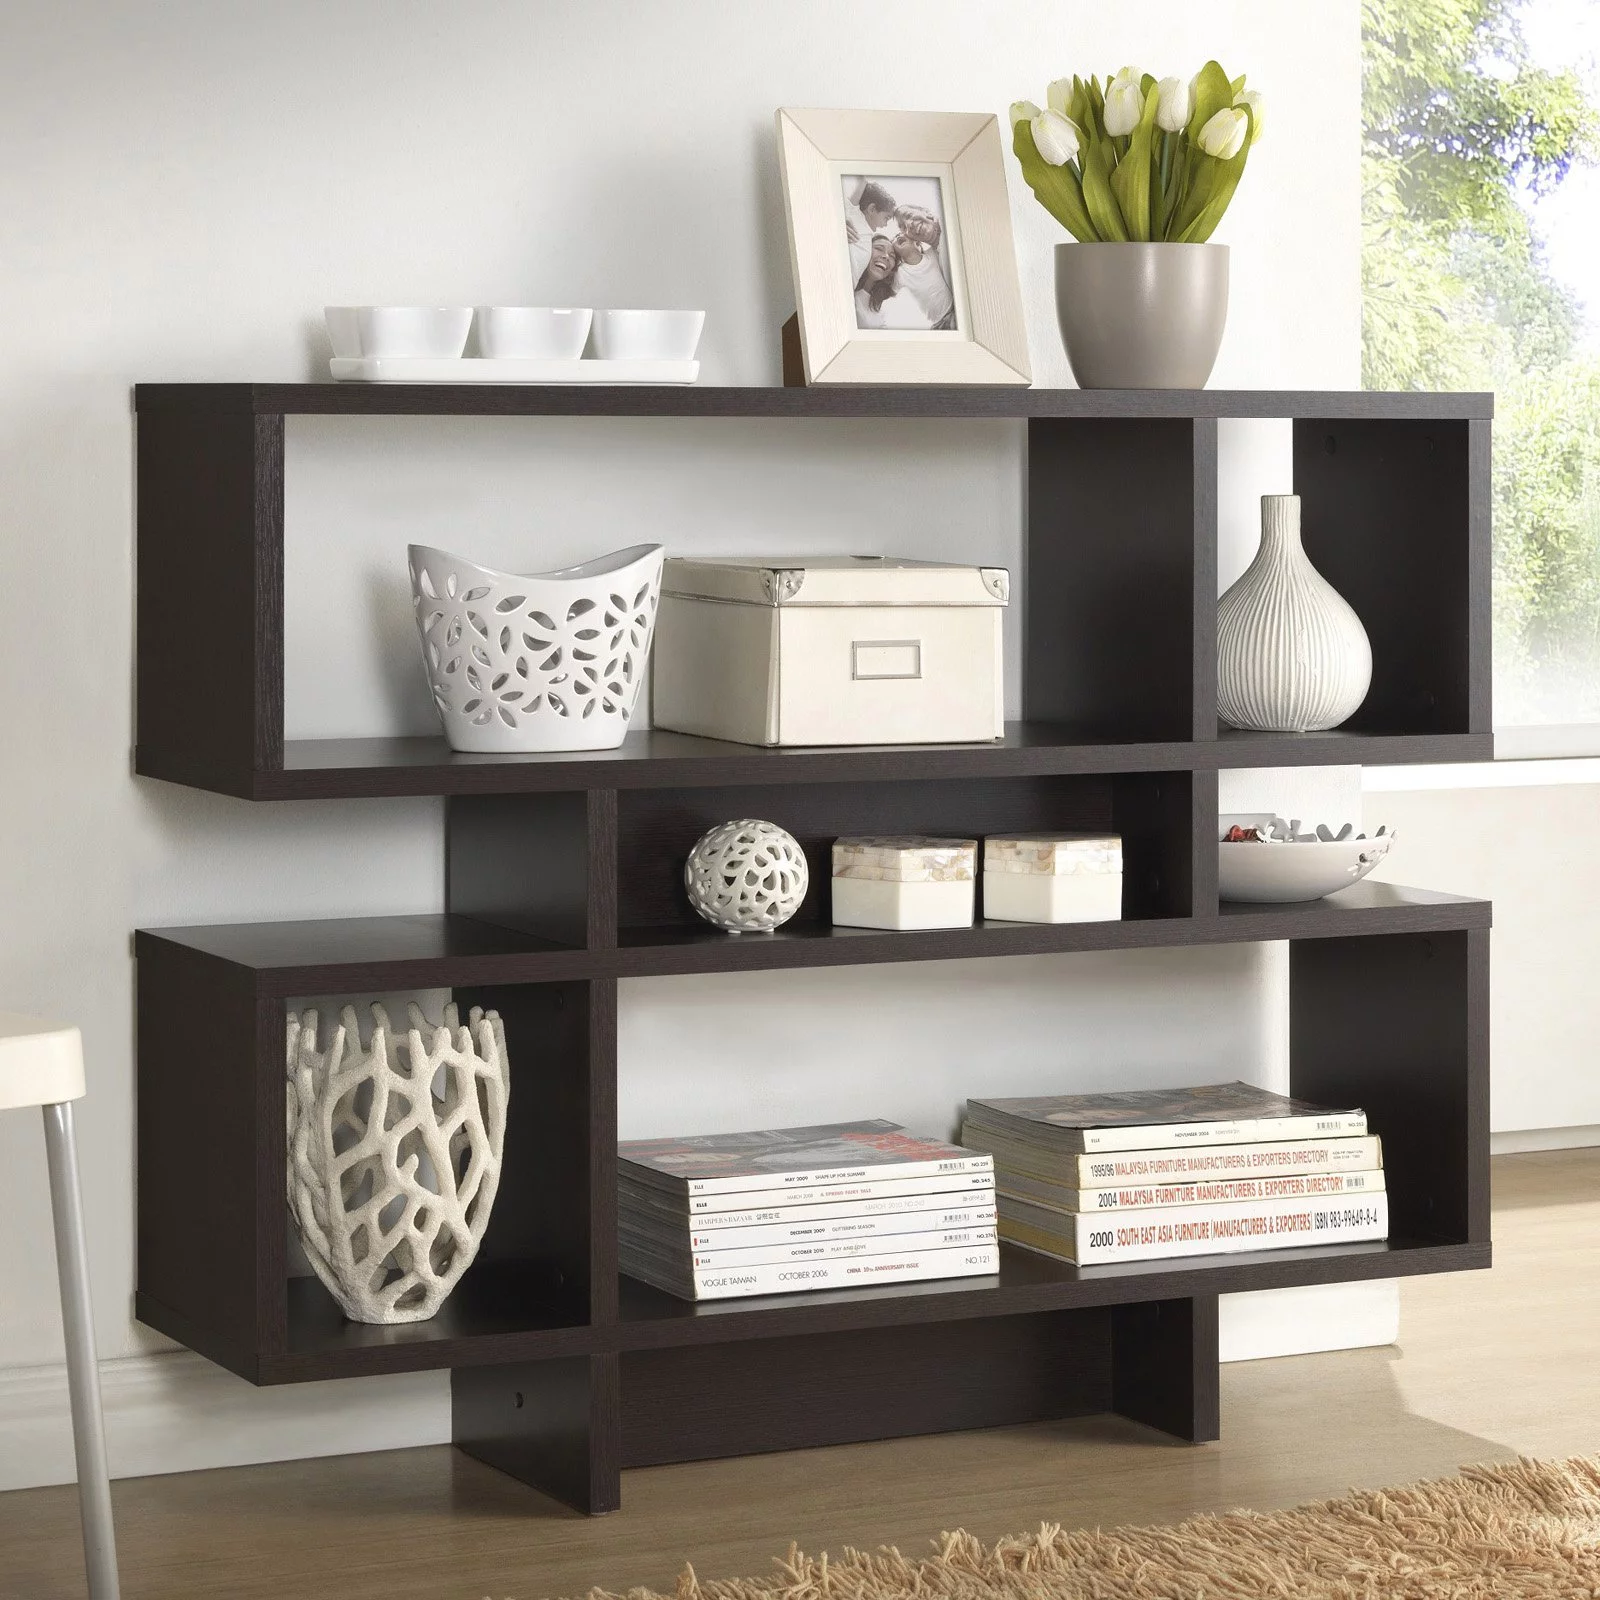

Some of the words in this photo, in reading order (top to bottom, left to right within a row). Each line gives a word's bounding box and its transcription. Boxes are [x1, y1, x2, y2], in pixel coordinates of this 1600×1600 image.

[1091, 1164, 1114, 1177] 1995/96
[1115, 1160, 1149, 1176] MALAYSIA
[1150, 1158, 1186, 1174] FURNITURE
[1188, 1154, 1246, 1171] MANUFACTURERS
[1246, 1155, 1252, 1167] &
[1252, 1152, 1292, 1167] EXPORTERS
[1293, 1150, 1329, 1164] DIRECTORY
[1098, 1192, 1118, 1208] 2004
[1119, 1190, 1154, 1206] MALAYSIA
[1155, 1187, 1195, 1204] FURNITURE
[1196, 1181, 1256, 1200] MANUFACTURERS
[1257, 1182, 1262, 1196] &
[1265, 1178, 1305, 1195] EXPORTERS
[1306, 1176, 1344, 1193] DIRECTORY
[728, 1215, 753, 1223] BAZAAR
[1090, 1231, 1114, 1248] 2000
[1117, 1227, 1139, 1247] SOUTH
[1141, 1226, 1156, 1244] EAST
[1158, 1224, 1173, 1243] ASIA
[1174, 1221, 1209, 1242] FURNITURE
[1210, 1217, 1268, 1241] (MANUFACTURERS
[1269, 1216, 1274, 1234] &
[1275, 1211, 1313, 1233] EXPORTERS)
[1314, 1212, 1328, 1230] ISBN
[1330, 1208, 1378, 1229] 983-99649-8-4
[965, 1255, 990, 1265] NO.121
[874, 1263, 905, 1272] ANNIVERSARY
[778, 1271, 810, 1281] OCTOBER
[811, 1269, 828, 1278] 2006
[702, 1278, 728, 1288] VOGUE
[729, 1276, 757, 1285] TAIWAN
